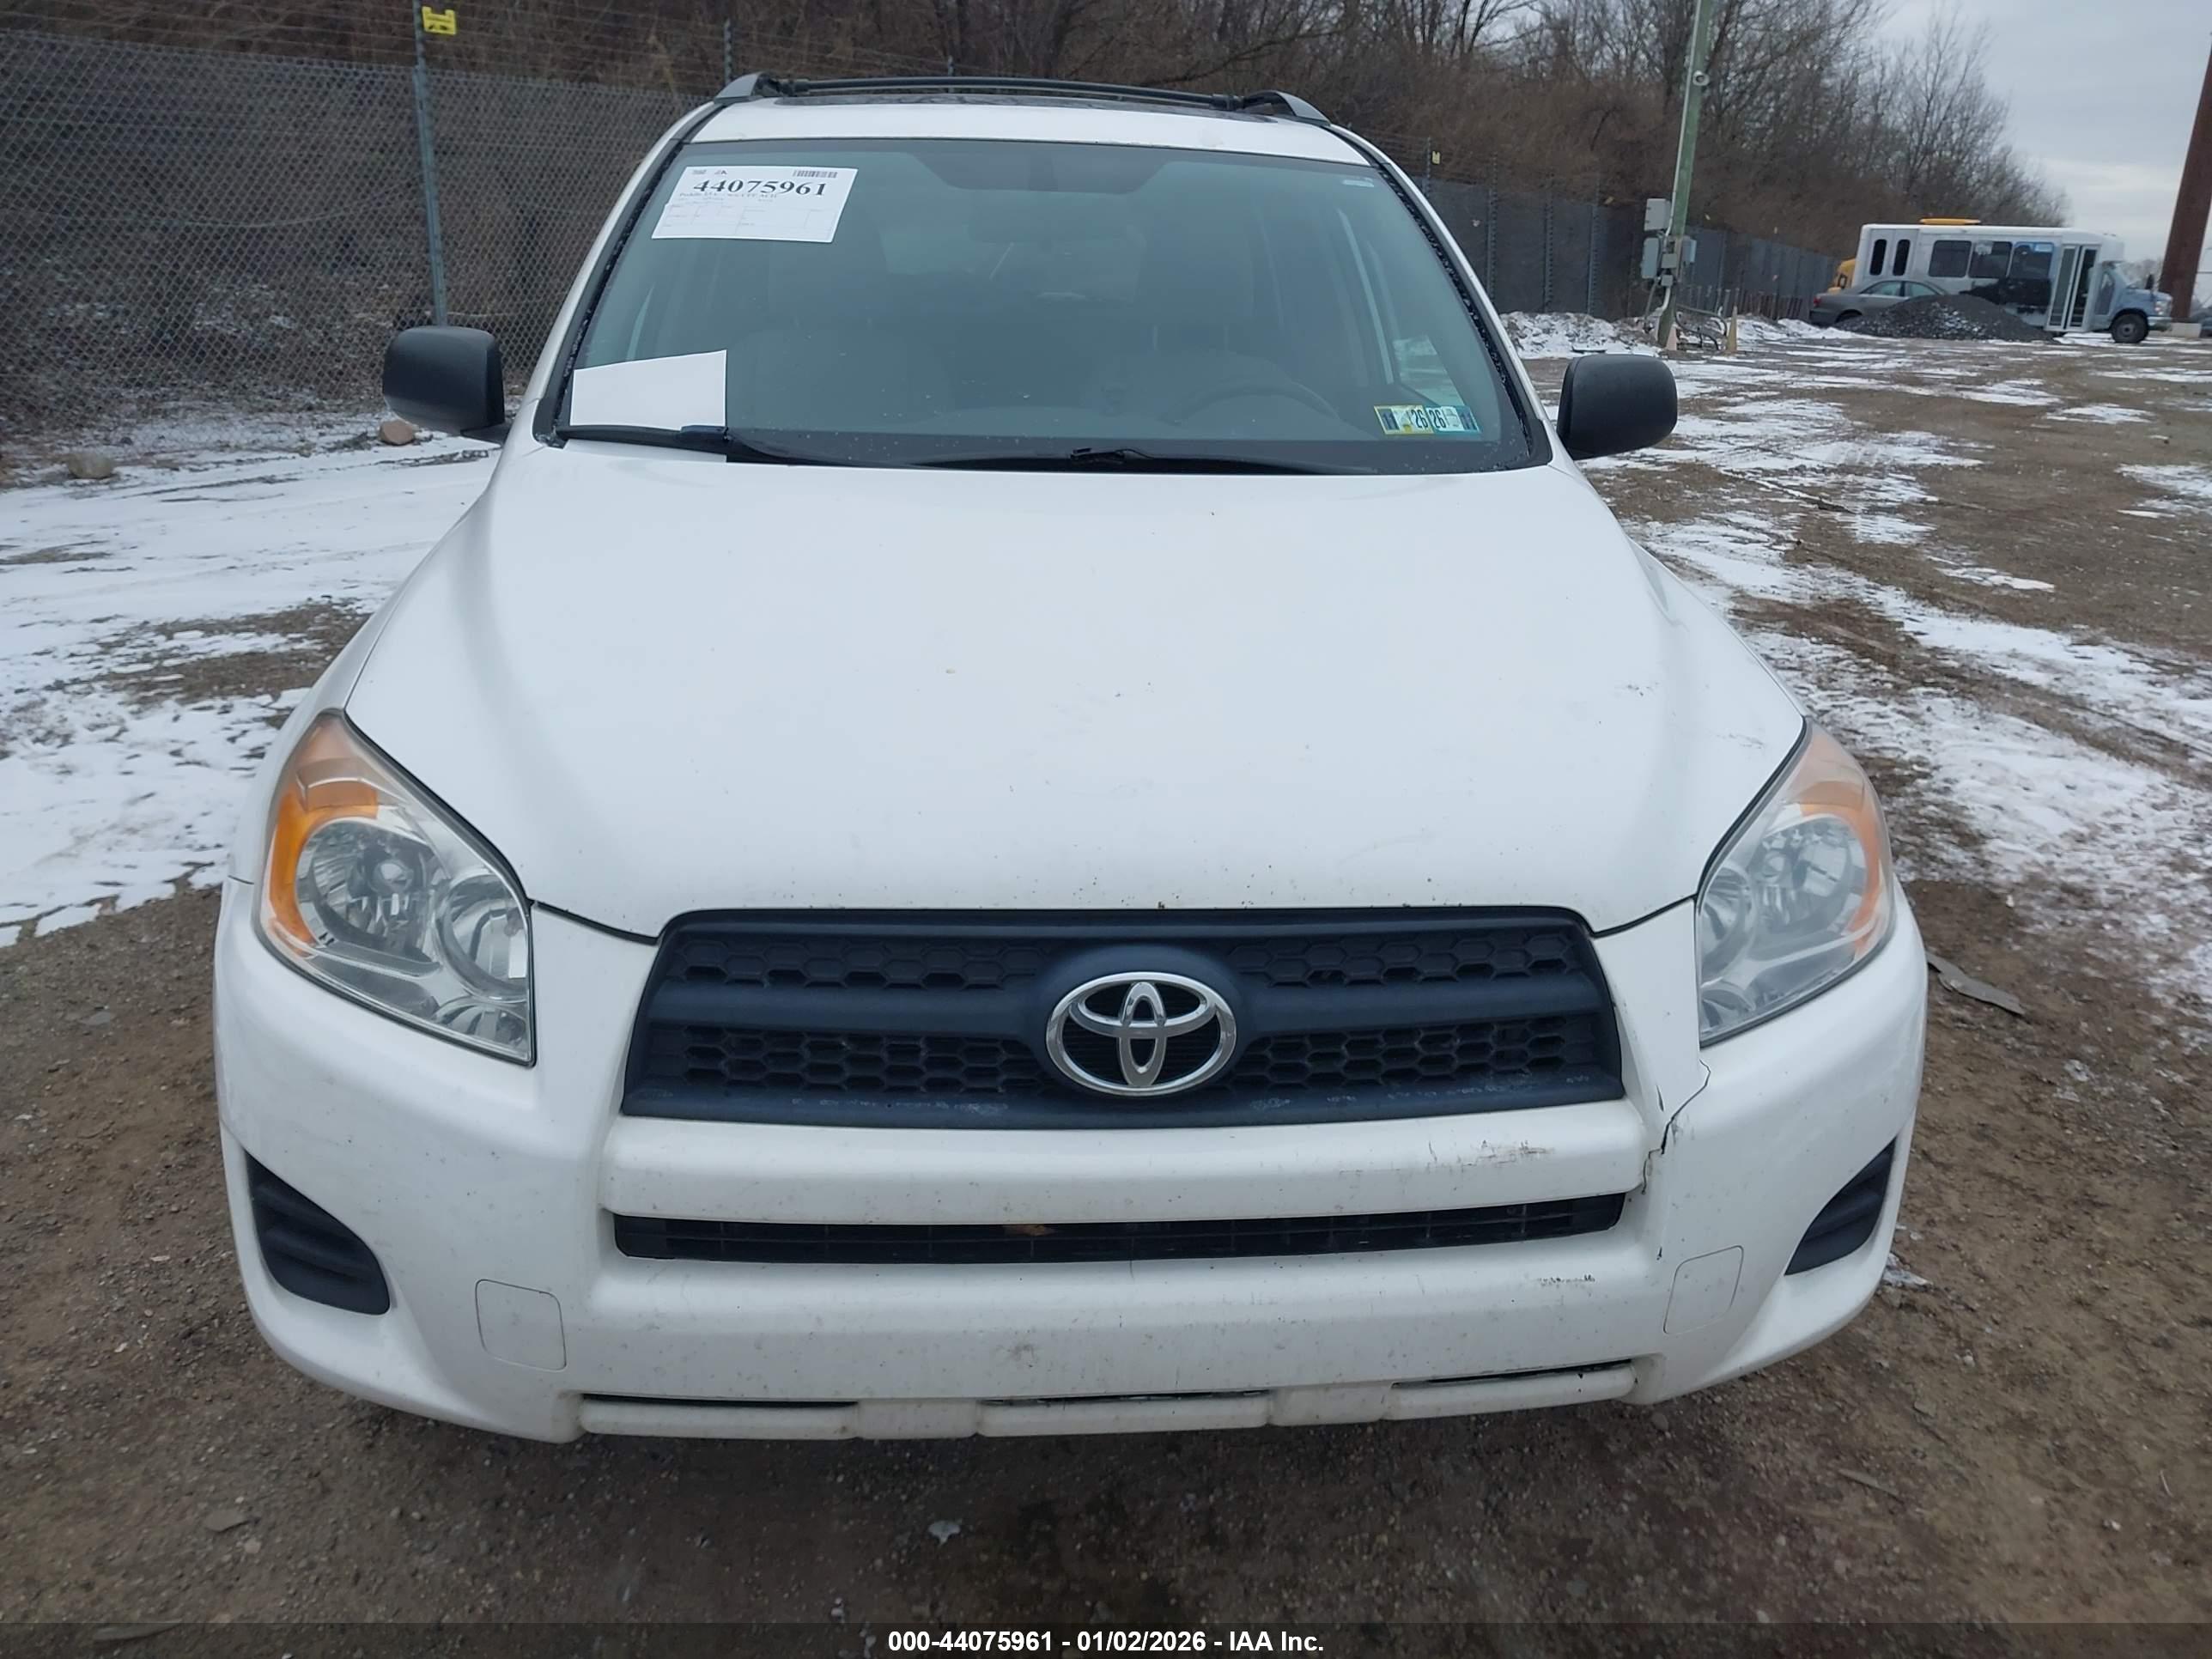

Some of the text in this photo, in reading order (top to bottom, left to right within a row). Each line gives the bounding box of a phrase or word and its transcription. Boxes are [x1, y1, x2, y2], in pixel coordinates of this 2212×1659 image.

[693, 179, 827, 197] 44075961
[1411, 409, 1429, 429] 26
[1429, 409, 1447, 429] 26
